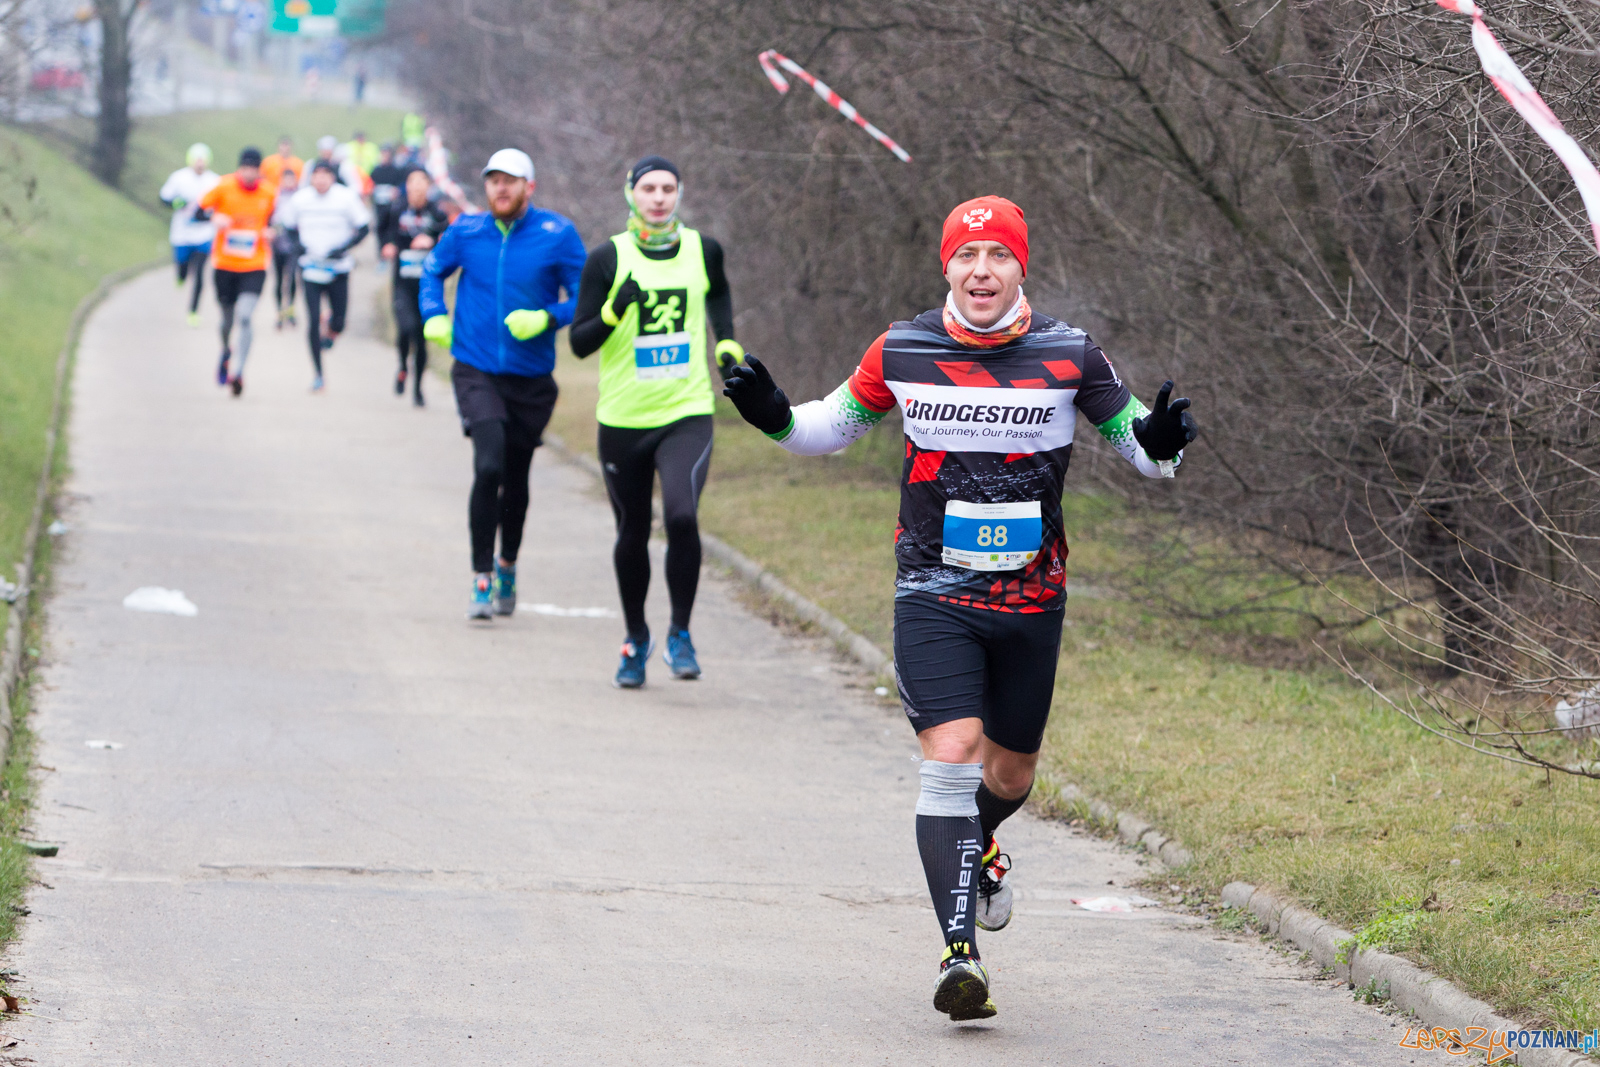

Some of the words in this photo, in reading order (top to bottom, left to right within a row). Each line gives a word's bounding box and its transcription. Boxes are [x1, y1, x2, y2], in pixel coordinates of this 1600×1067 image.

[651, 346, 679, 365] 167
[906, 398, 1056, 425] BRIDGESTONE
[912, 424, 930, 435] Your
[932, 426, 979, 439] Journey,
[982, 428, 1003, 438] Our
[1005, 429, 1043, 439] Passion
[977, 525, 1008, 547] 88
[947, 838, 983, 933] Kalenji
